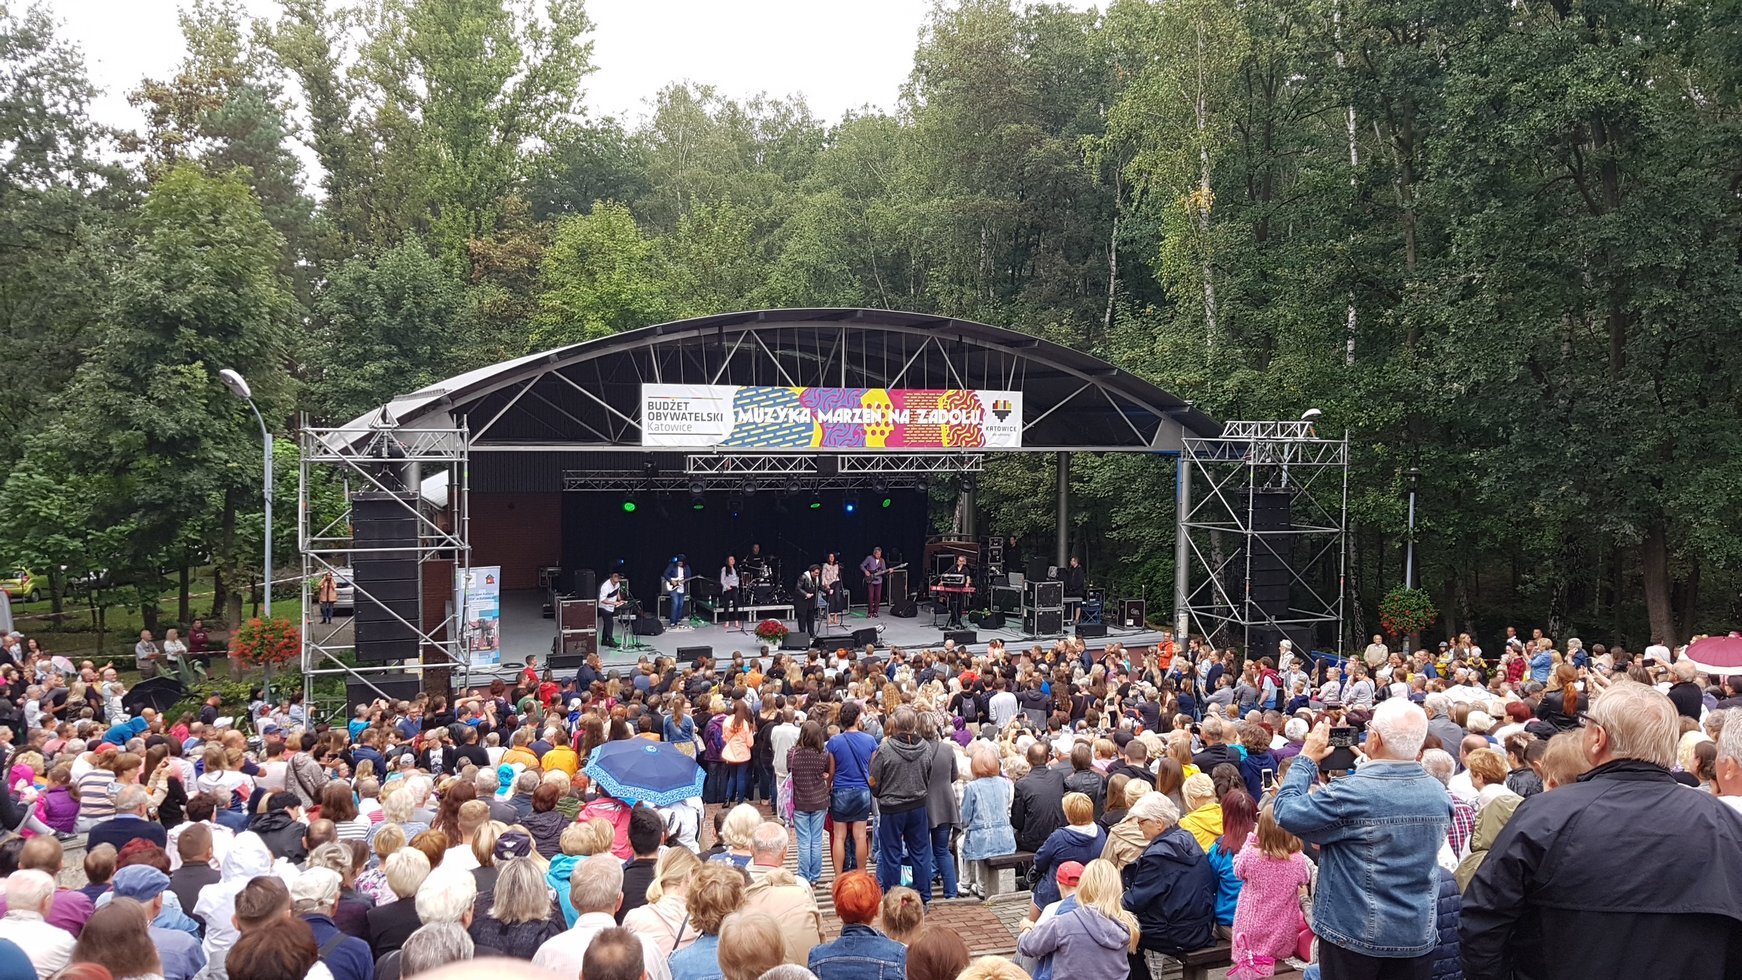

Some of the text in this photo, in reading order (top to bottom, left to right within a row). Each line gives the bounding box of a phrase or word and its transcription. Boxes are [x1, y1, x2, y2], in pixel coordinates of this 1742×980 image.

[647, 399, 690, 411] BUDŻET
[647, 411, 724, 423] OBYWATELSKI
[737, 407, 811, 424] MUZYKA
[887, 408, 910, 425] NA
[647, 422, 693, 432] Katowice
